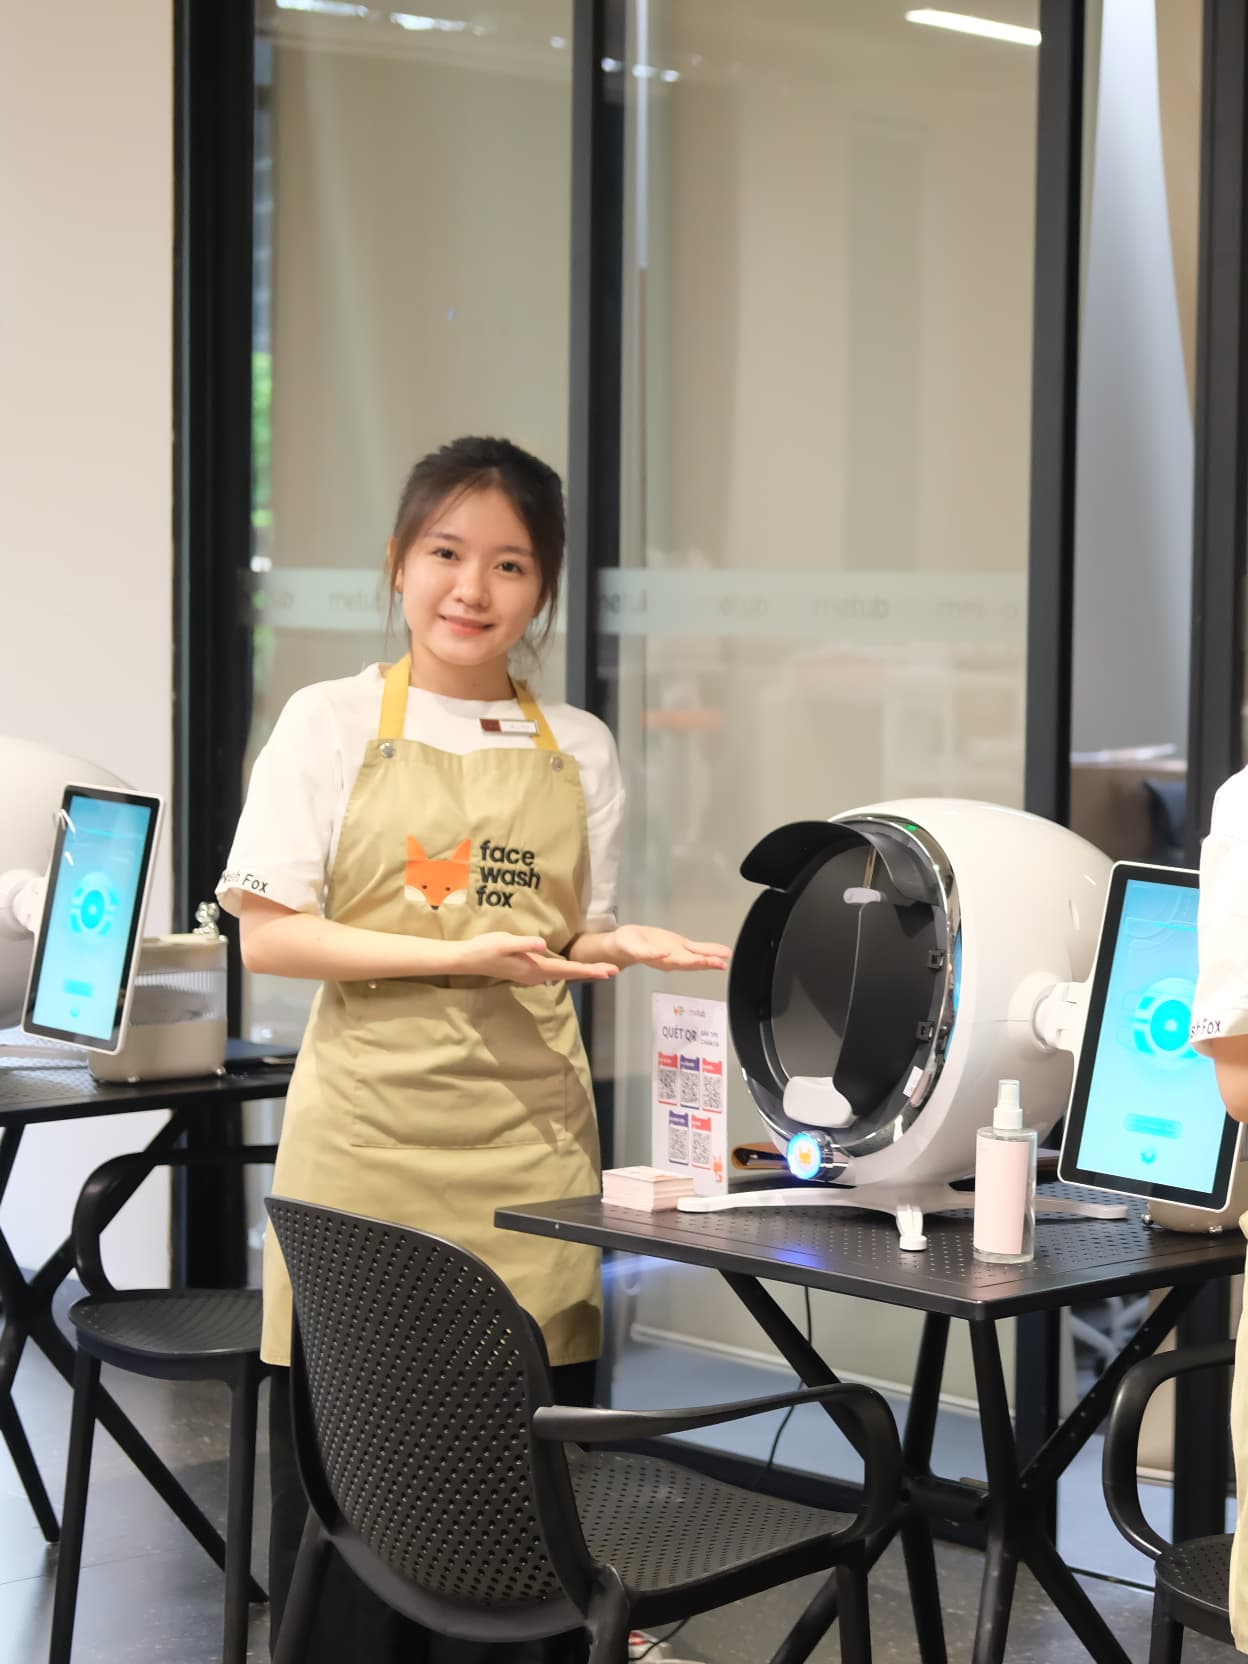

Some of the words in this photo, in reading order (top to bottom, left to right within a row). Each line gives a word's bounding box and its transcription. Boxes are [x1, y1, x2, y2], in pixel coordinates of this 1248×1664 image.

[479, 839, 535, 867] face
[241, 873, 269, 894] Fox
[479, 865, 541, 890] wash
[475, 884, 514, 909] fox
